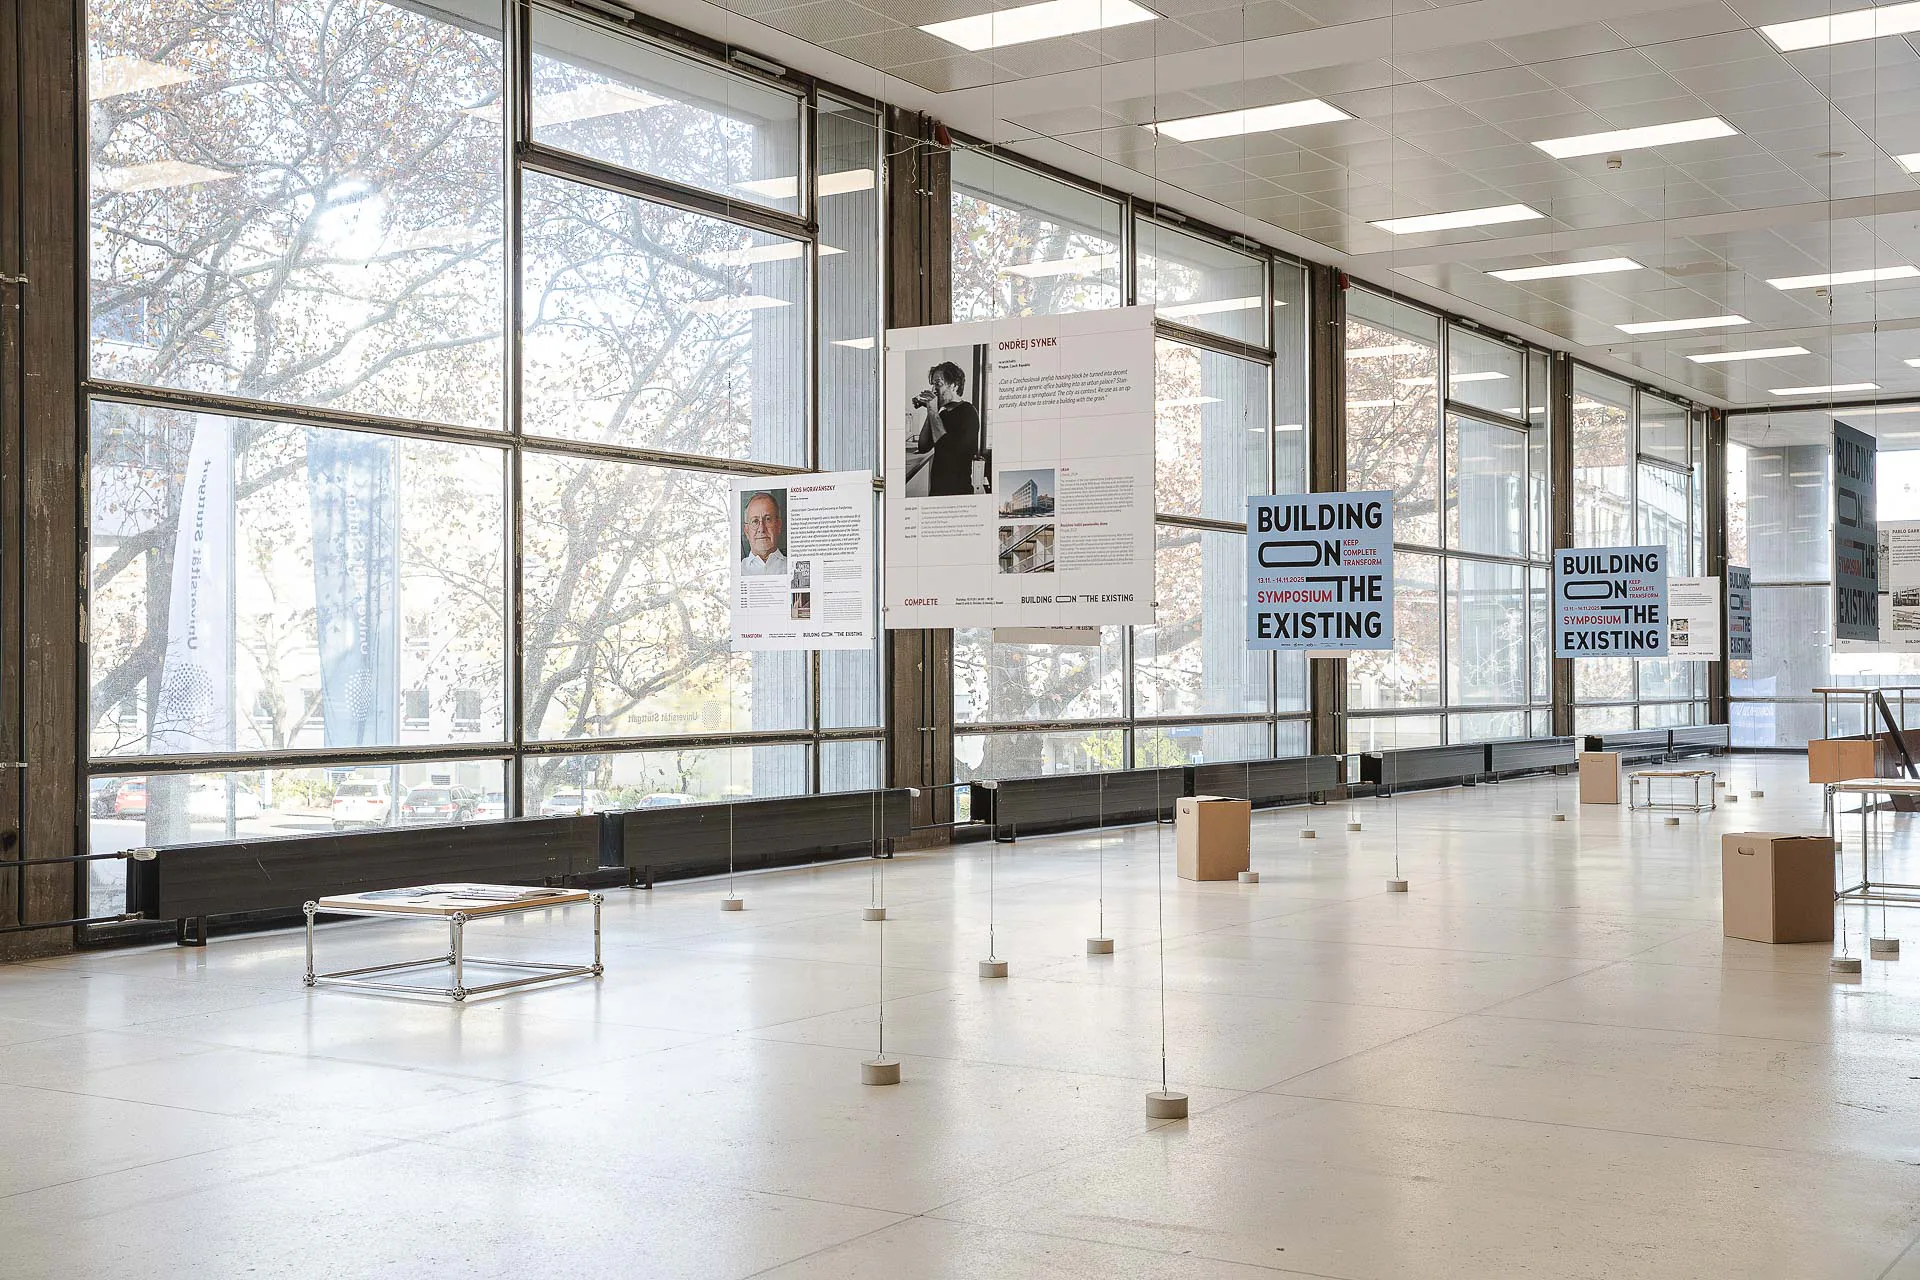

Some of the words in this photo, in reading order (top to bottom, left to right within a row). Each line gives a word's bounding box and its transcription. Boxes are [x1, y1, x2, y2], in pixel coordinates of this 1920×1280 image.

[999, 338, 1028, 350] ONDŘEJ
[1031, 337, 1057, 348] SYNEK
[1055, 381, 1071, 389] building
[1837, 437, 1874, 485] BUILDING
[1257, 501, 1383, 533] BUILDING
[1838, 486, 1864, 529] ON
[1257, 539, 1341, 568] ON
[1343, 548, 1377, 556] COMPLETE
[1343, 558, 1382, 566] TRANSFORM
[1853, 540, 1875, 580] THE
[1563, 553, 1659, 575] BUILDING
[1838, 555, 1861, 577] SYMPOSIUM
[1306, 575, 1383, 602] THE
[1563, 580, 1628, 600] ON
[1729, 572, 1750, 590] BUILDING
[904, 598, 938, 606] COMPLETE
[1021, 595, 1052, 604] BUILDING
[1079, 594, 1099, 602] THE
[1101, 594, 1134, 602] EXISTING
[1257, 590, 1333, 603] SYMPOSIUM
[1839, 587, 1875, 626] EXISTING
[1563, 615, 1621, 625] SYMPOSIUM
[1600, 605, 1659, 624] THE
[1257, 611, 1382, 639] EXISTING
[1564, 630, 1659, 650] EXISTING
[1730, 636, 1751, 654] EXISTING
